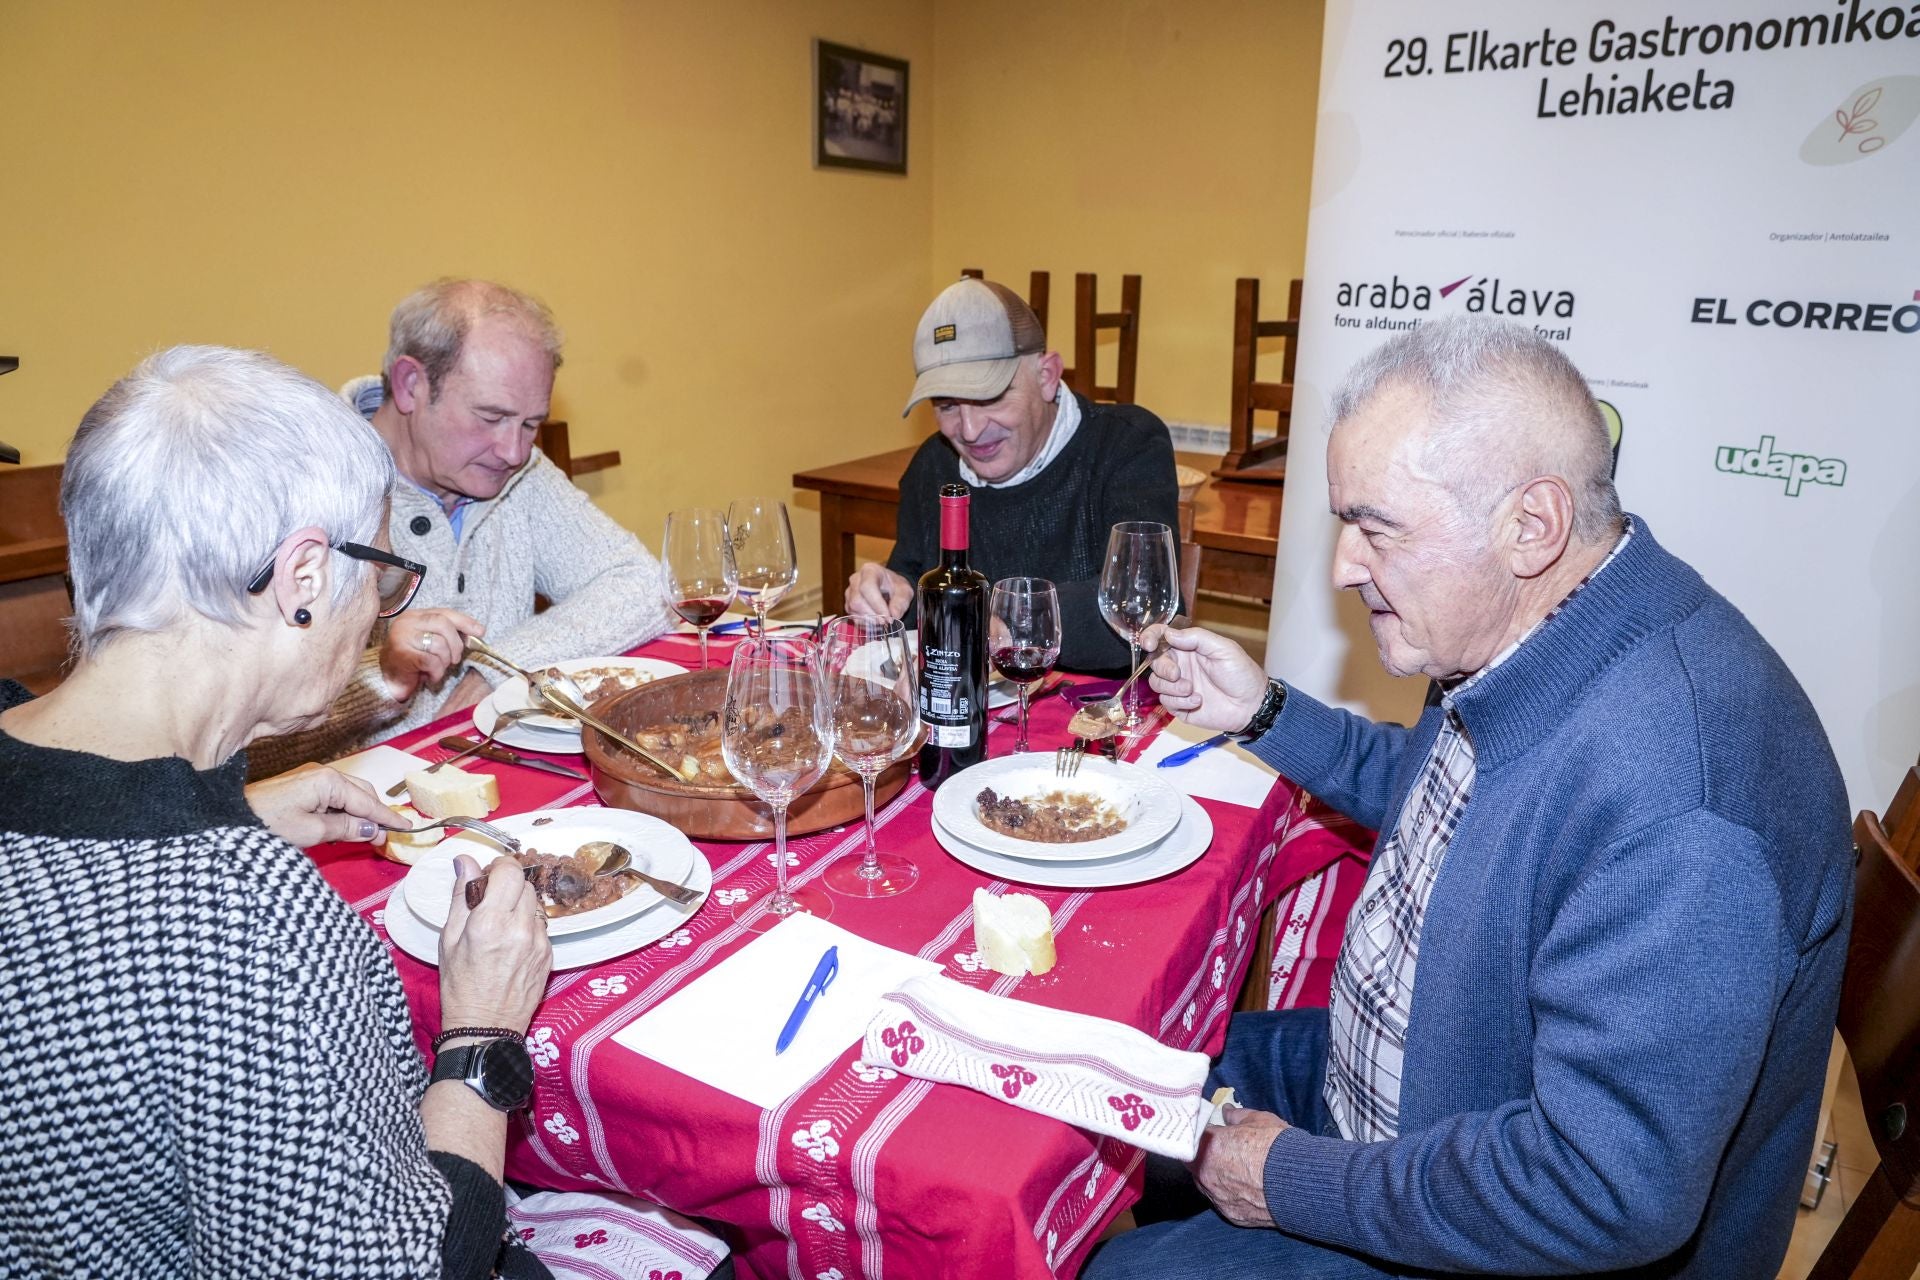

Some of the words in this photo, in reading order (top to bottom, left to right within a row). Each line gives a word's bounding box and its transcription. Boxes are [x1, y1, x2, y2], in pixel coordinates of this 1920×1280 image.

[1384, 37, 1434, 77] 29.
[1444, 28, 1577, 74] Elkarte
[1537, 68, 1735, 118] Lehiaketa
[1769, 232, 1824, 243] Organizador
[1829, 232, 1890, 242] Antolatzailea
[1336, 275, 1432, 311] araba
[1466, 278, 1576, 318] álava
[1690, 297, 1737, 325] EL
[1745, 298, 1920, 334] CORREO
[1334, 314, 1361, 328] foru
[1365, 315, 1423, 331] aldundi
[1715, 435, 1847, 498] udapa
